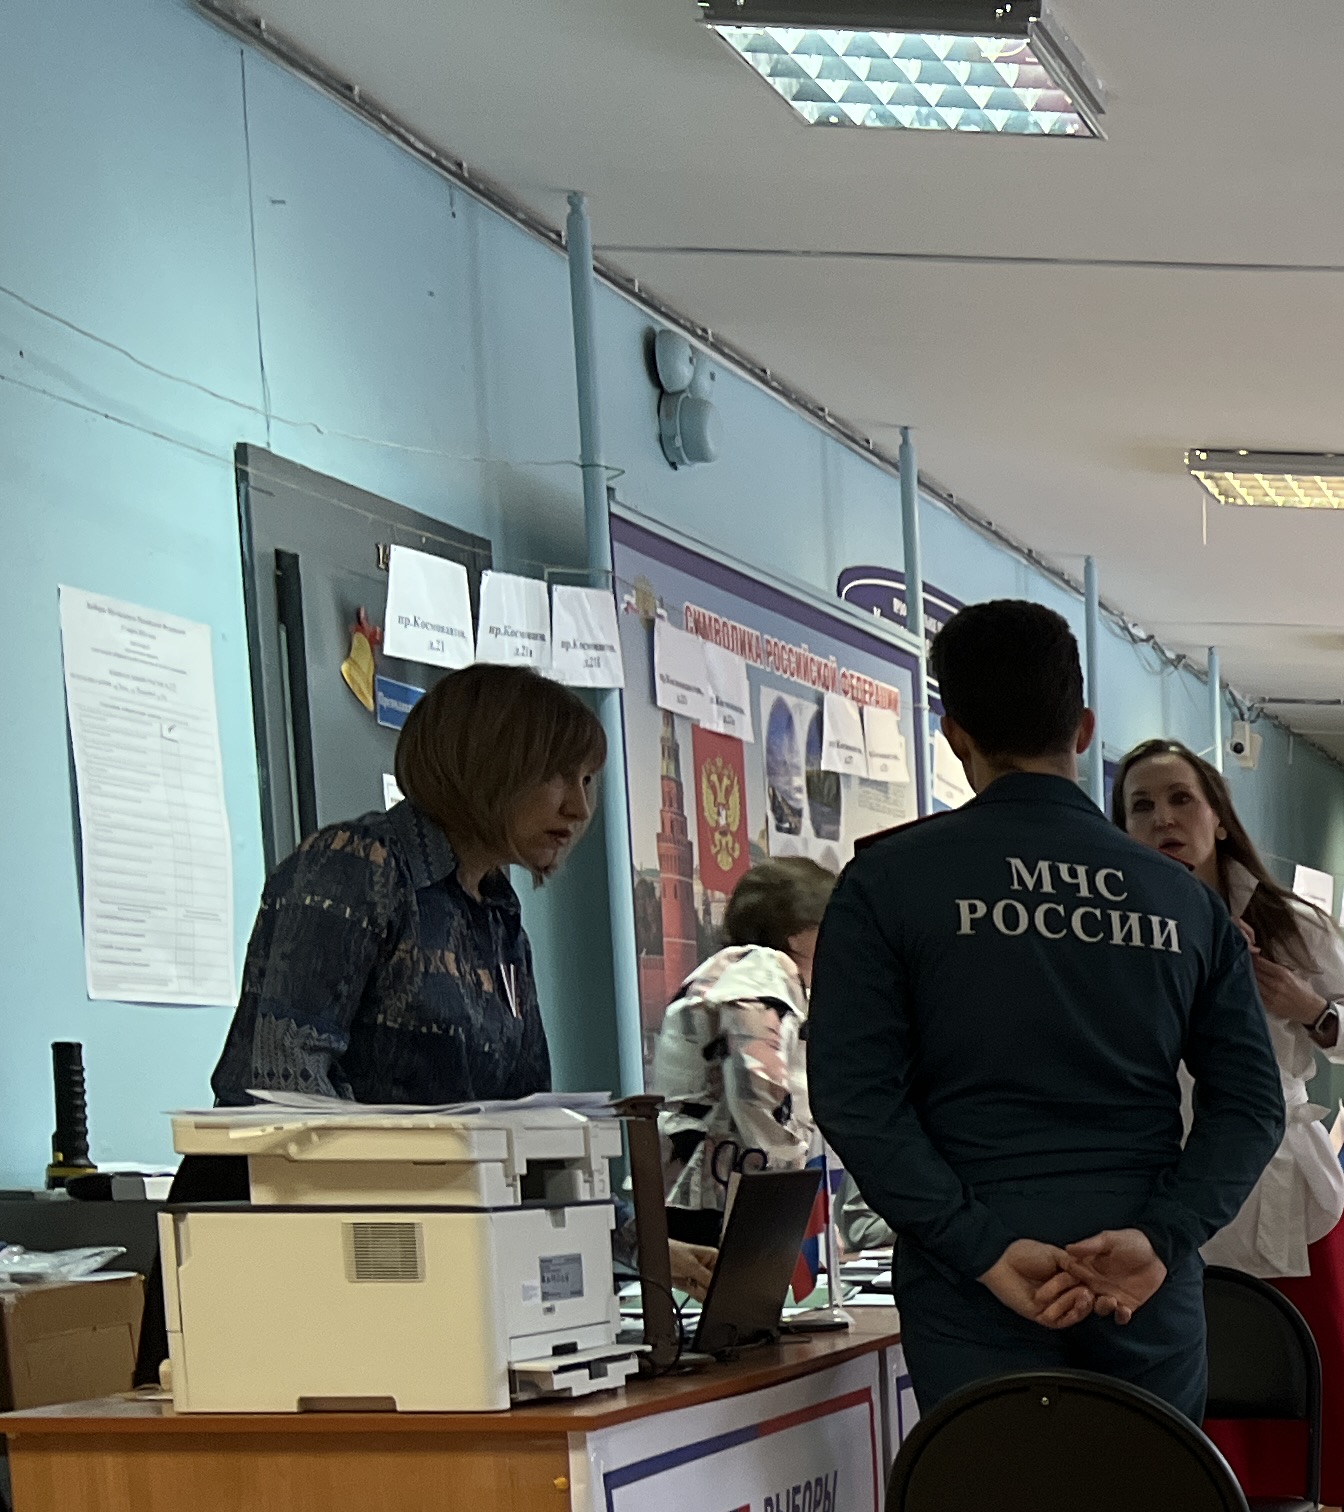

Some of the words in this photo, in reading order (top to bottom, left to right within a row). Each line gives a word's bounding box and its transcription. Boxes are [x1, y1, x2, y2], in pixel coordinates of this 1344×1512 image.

[684, 602, 764, 668] СИМВОЛИКА
[764, 634, 838, 694] РОССИЙСКОЙ
[1006, 857, 1128, 901] МЧС
[955, 899, 1182, 954] РОССИИ
